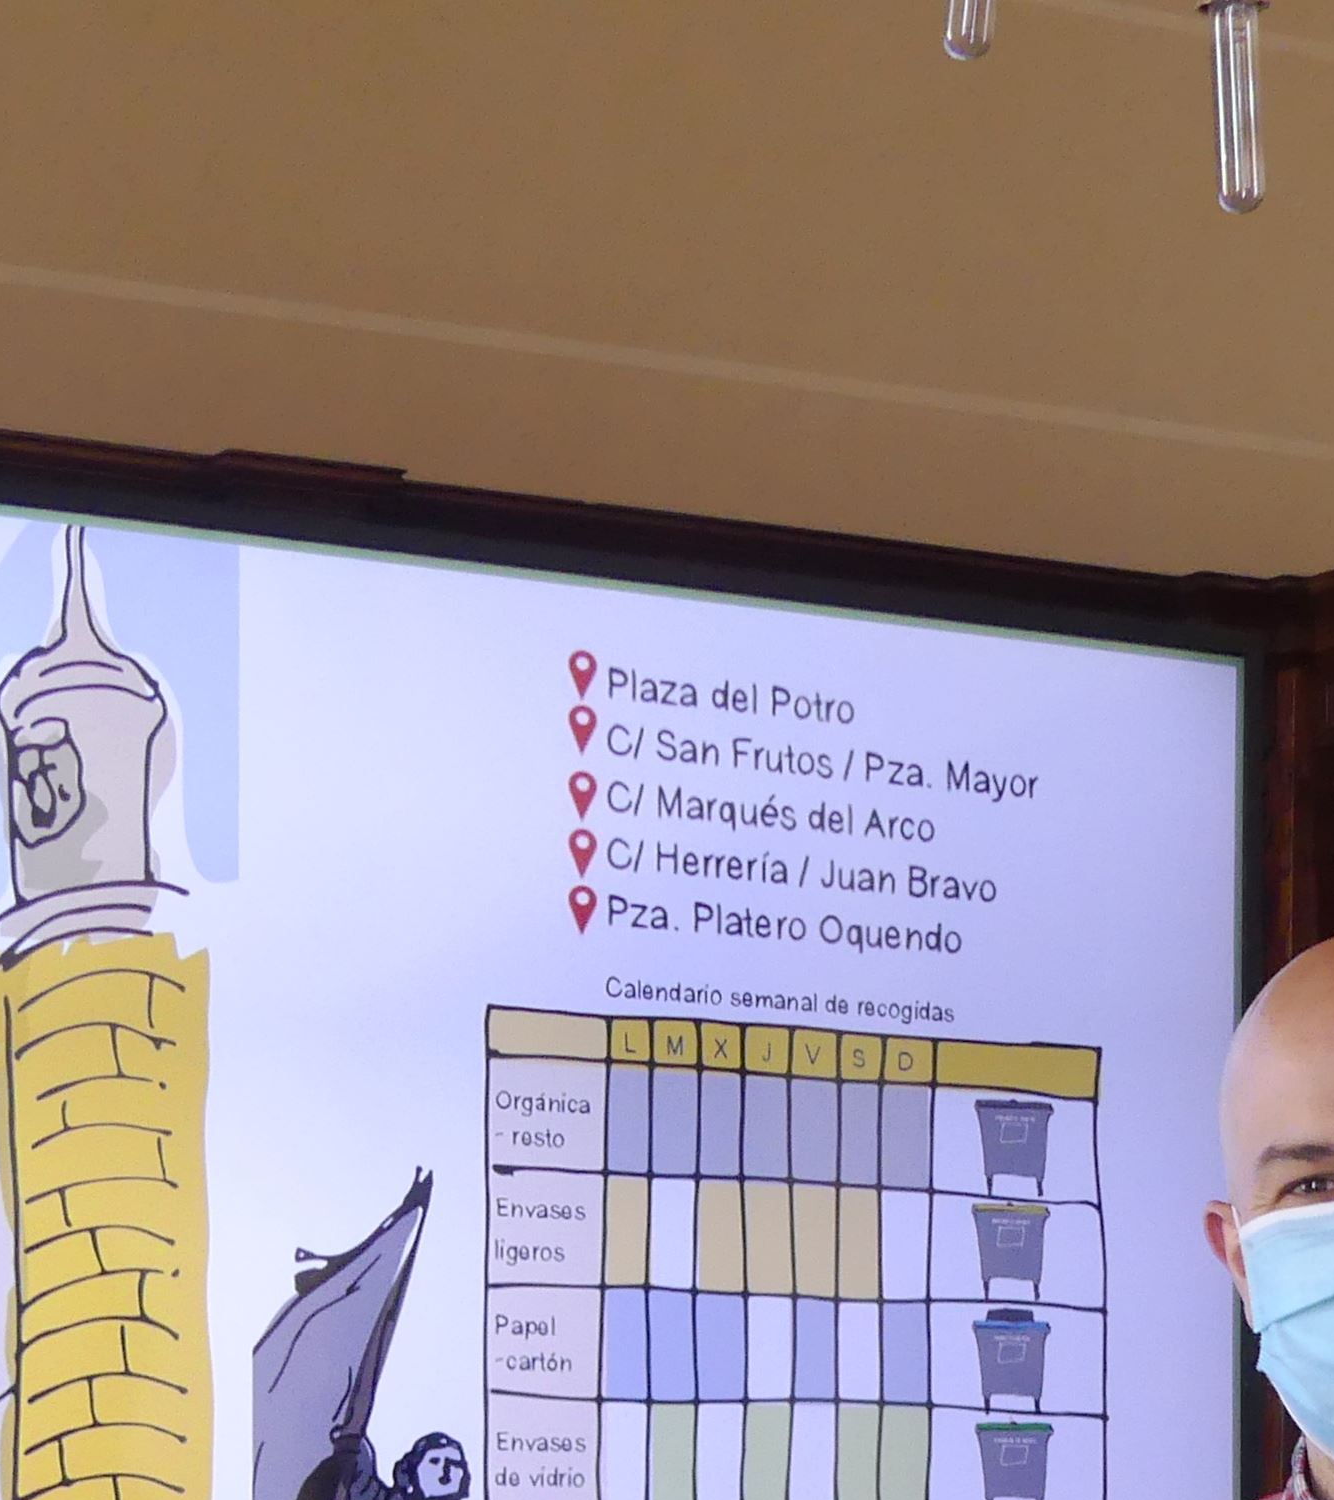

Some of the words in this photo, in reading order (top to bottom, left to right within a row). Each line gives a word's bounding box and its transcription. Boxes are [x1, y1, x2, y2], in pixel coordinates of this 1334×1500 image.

[609, 667, 697, 707] Plaza
[712, 680, 757, 714] del
[772, 685, 854, 724] Potro
[607, 724, 644, 759] C/
[657, 729, 719, 766] San
[733, 738, 833, 779] Frutos
[866, 752, 931, 788] Pza.
[947, 760, 1038, 802] Mayor
[607, 781, 644, 816] C/
[658, 785, 797, 831] Marqués
[809, 802, 852, 835] del
[865, 809, 935, 842] Arco
[607, 838, 644, 873] C/
[657, 842, 787, 884] Herrería
[821, 860, 895, 894] Juan
[909, 865, 996, 902] Bravo
[608, 894, 678, 931] Pza.
[694, 902, 806, 941] Platero
[820, 915, 962, 954] Oquendo
[606, 976, 722, 1005] Calendario
[731, 992, 817, 1012] semanal
[825, 995, 848, 1014] de
[858, 1001, 954, 1024] recogidas
[625, 1032, 636, 1053] L
[667, 1036, 683, 1055] M
[714, 1039, 727, 1059] X
[805, 1044, 821, 1064] V
[853, 1049, 865, 1068] S
[898, 1052, 913, 1071] D
[496, 1091, 590, 1116] Orgánica
[513, 1129, 565, 1148] resto
[496, 1198, 586, 1220] Envases
[495, 1239, 565, 1266] ligeros
[495, 1314, 555, 1340] Papel
[497, 1432, 586, 1452] Envases
[495, 1467, 519, 1487] de
[530, 1467, 585, 1488] vidrio
